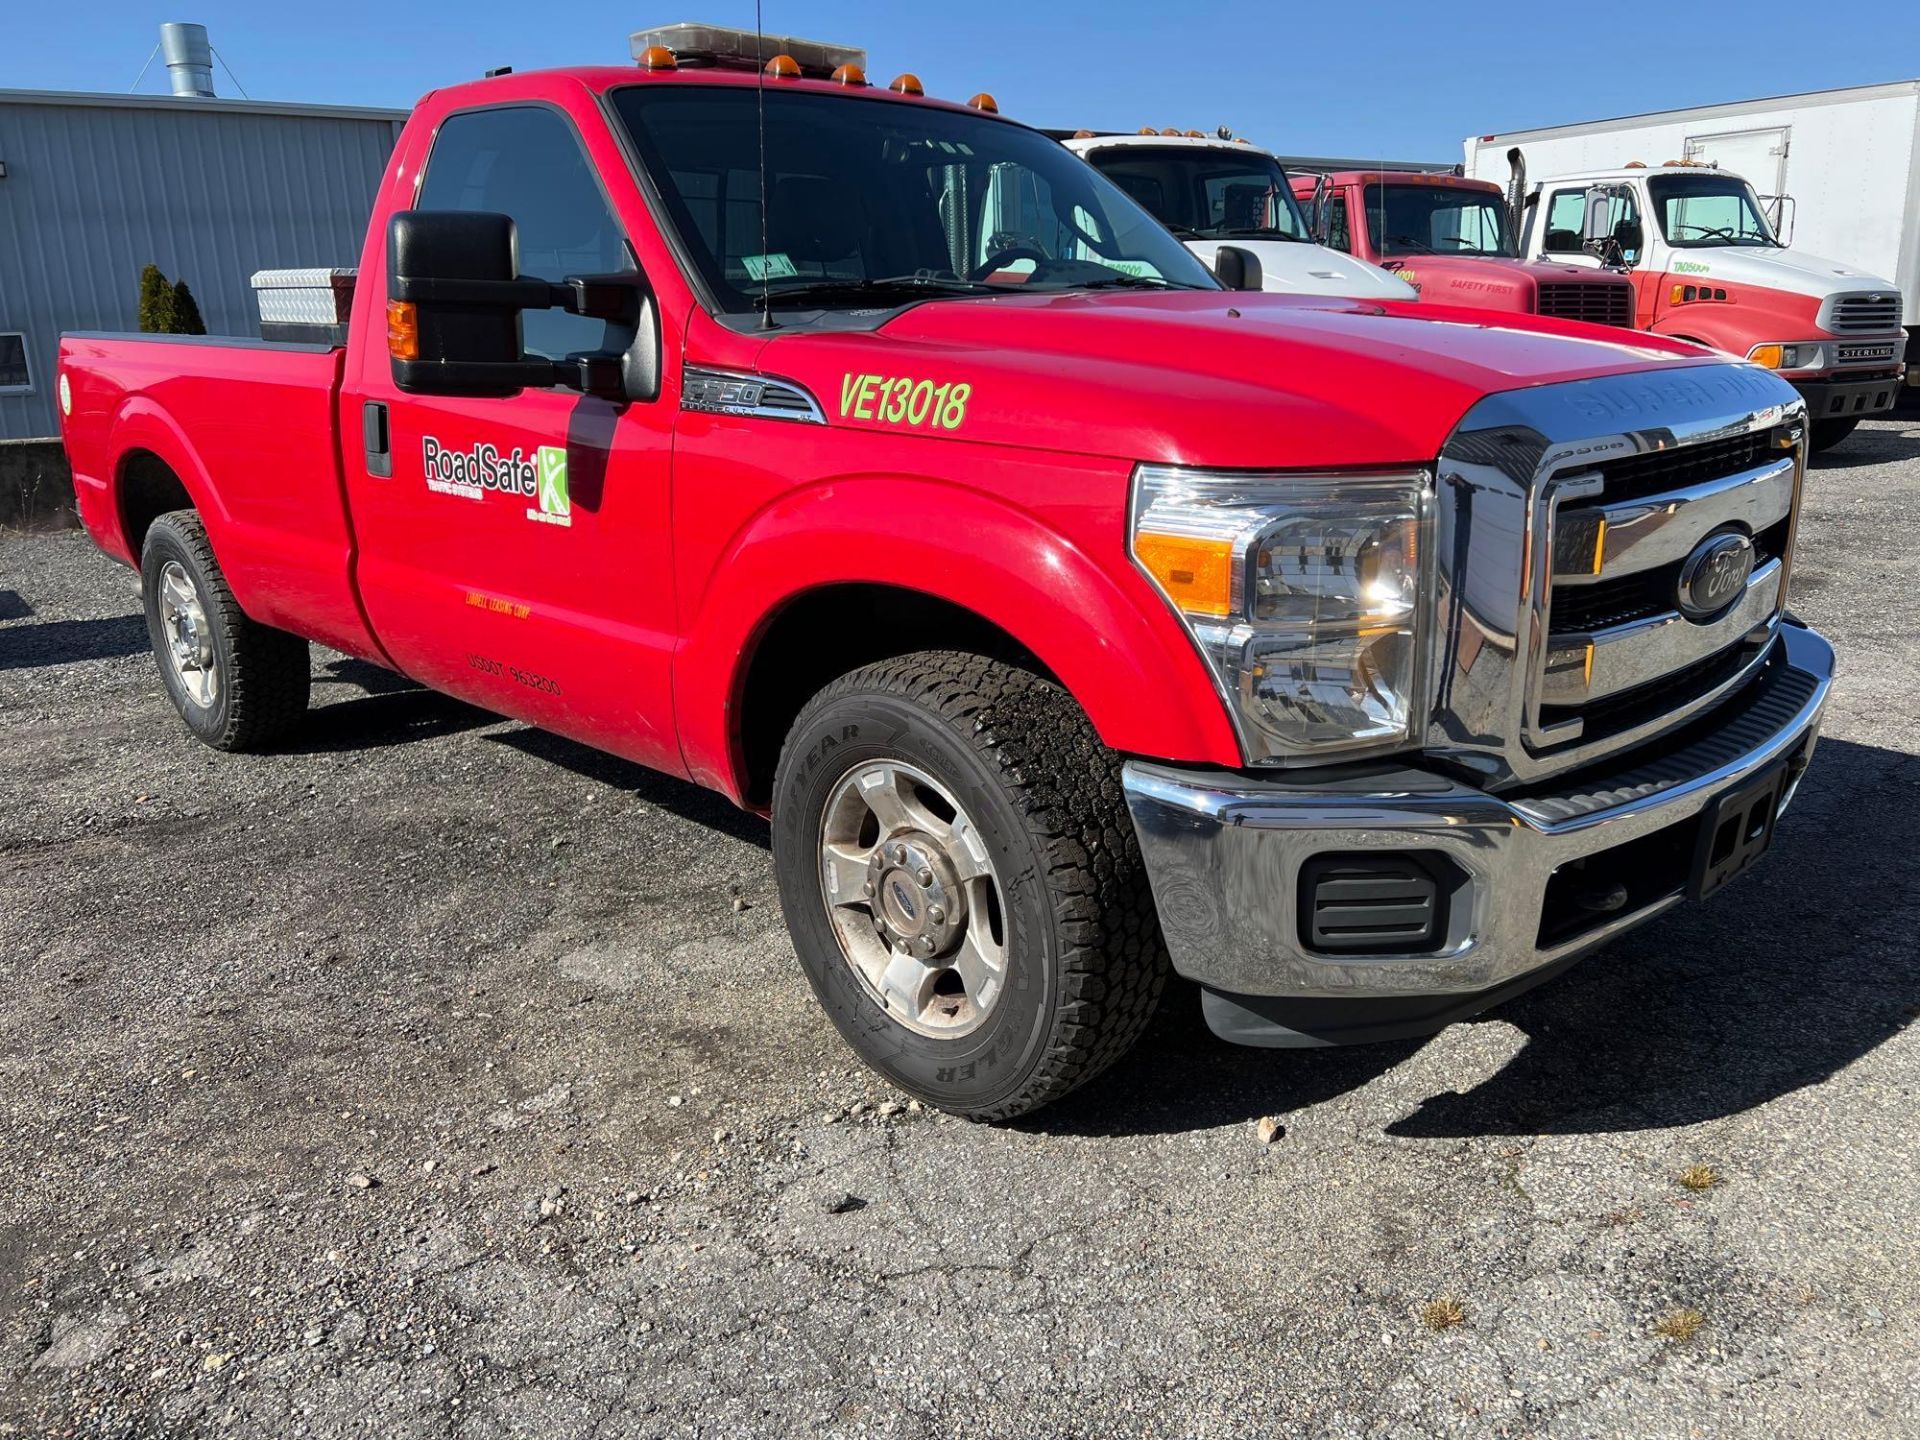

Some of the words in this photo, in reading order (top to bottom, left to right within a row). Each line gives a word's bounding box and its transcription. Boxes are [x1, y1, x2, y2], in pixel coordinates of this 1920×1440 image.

[1450, 279, 1486, 291] SAFETY
[1487, 283, 1515, 295] FIRST
[1843, 347, 1892, 357] STERLING
[839, 372, 971, 430] VE13018
[422, 435, 537, 497] RoadSafe
[1708, 549, 1749, 598] Ford
[488, 597, 513, 615] LEASING
[467, 653, 505, 680] USDOT
[509, 666, 561, 696] 963200
